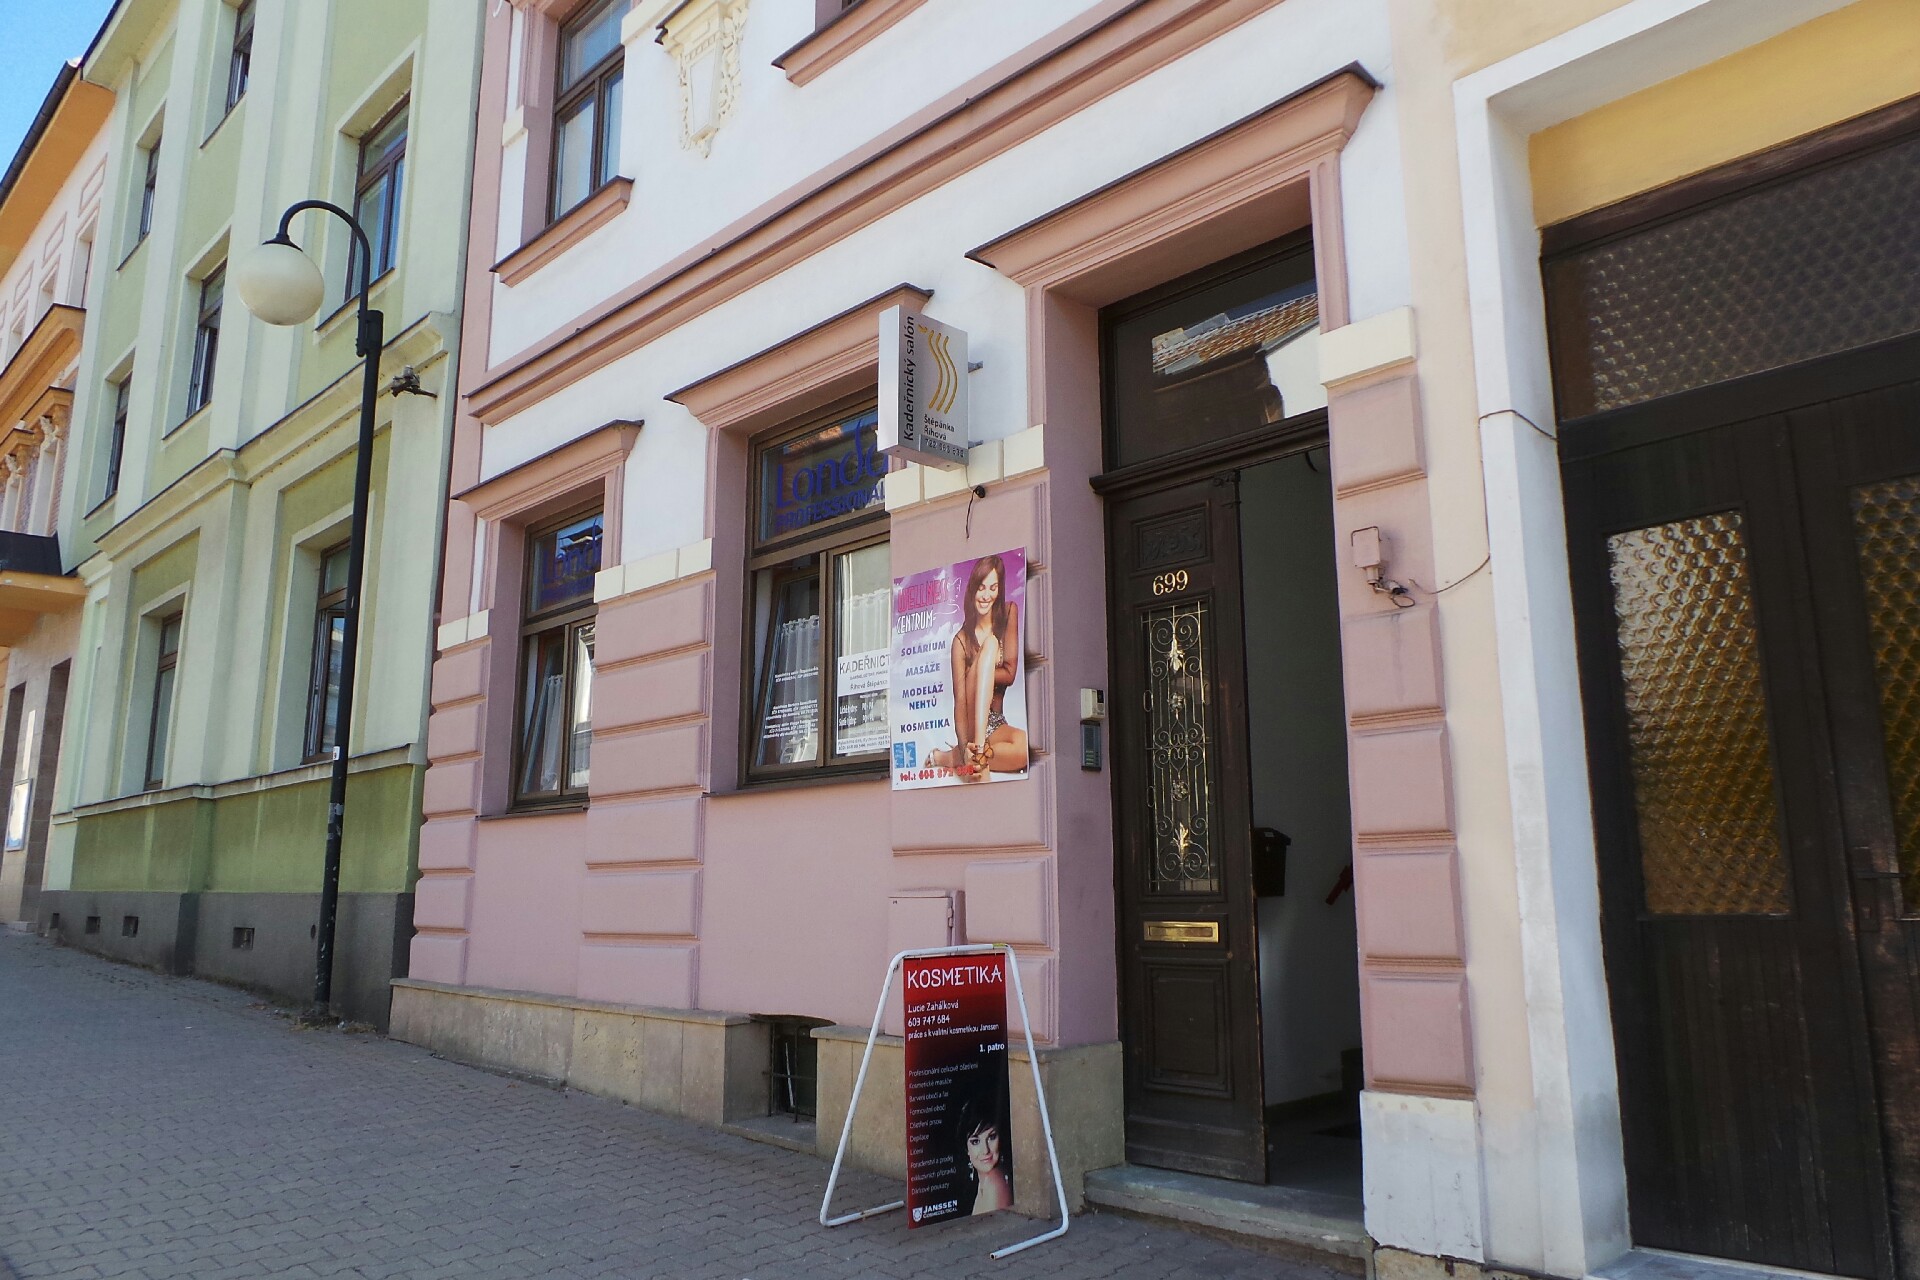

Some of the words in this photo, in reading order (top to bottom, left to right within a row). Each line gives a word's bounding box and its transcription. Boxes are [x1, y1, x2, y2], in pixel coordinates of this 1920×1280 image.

[904, 316, 915, 355] salón
[904, 360, 916, 441] Kadeřnický
[924, 413, 955, 432] Štěpánka
[543, 518, 602, 584] Lond
[1152, 570, 1188, 596] 699
[896, 609, 934, 634] CENTRUM
[905, 661, 940, 677] MASÁŽE
[902, 681, 944, 698] MODELÁŽ
[909, 695, 937, 710] NEHTŮ
[900, 718, 950, 733] KOSMETIKA
[907, 964, 1003, 989] KOSMETIKA
[908, 1004, 925, 1013] Lucie
[979, 1044, 986, 1052] 1.
[987, 1043, 1005, 1053] patro
[923, 1199, 958, 1214] JANSSEN
